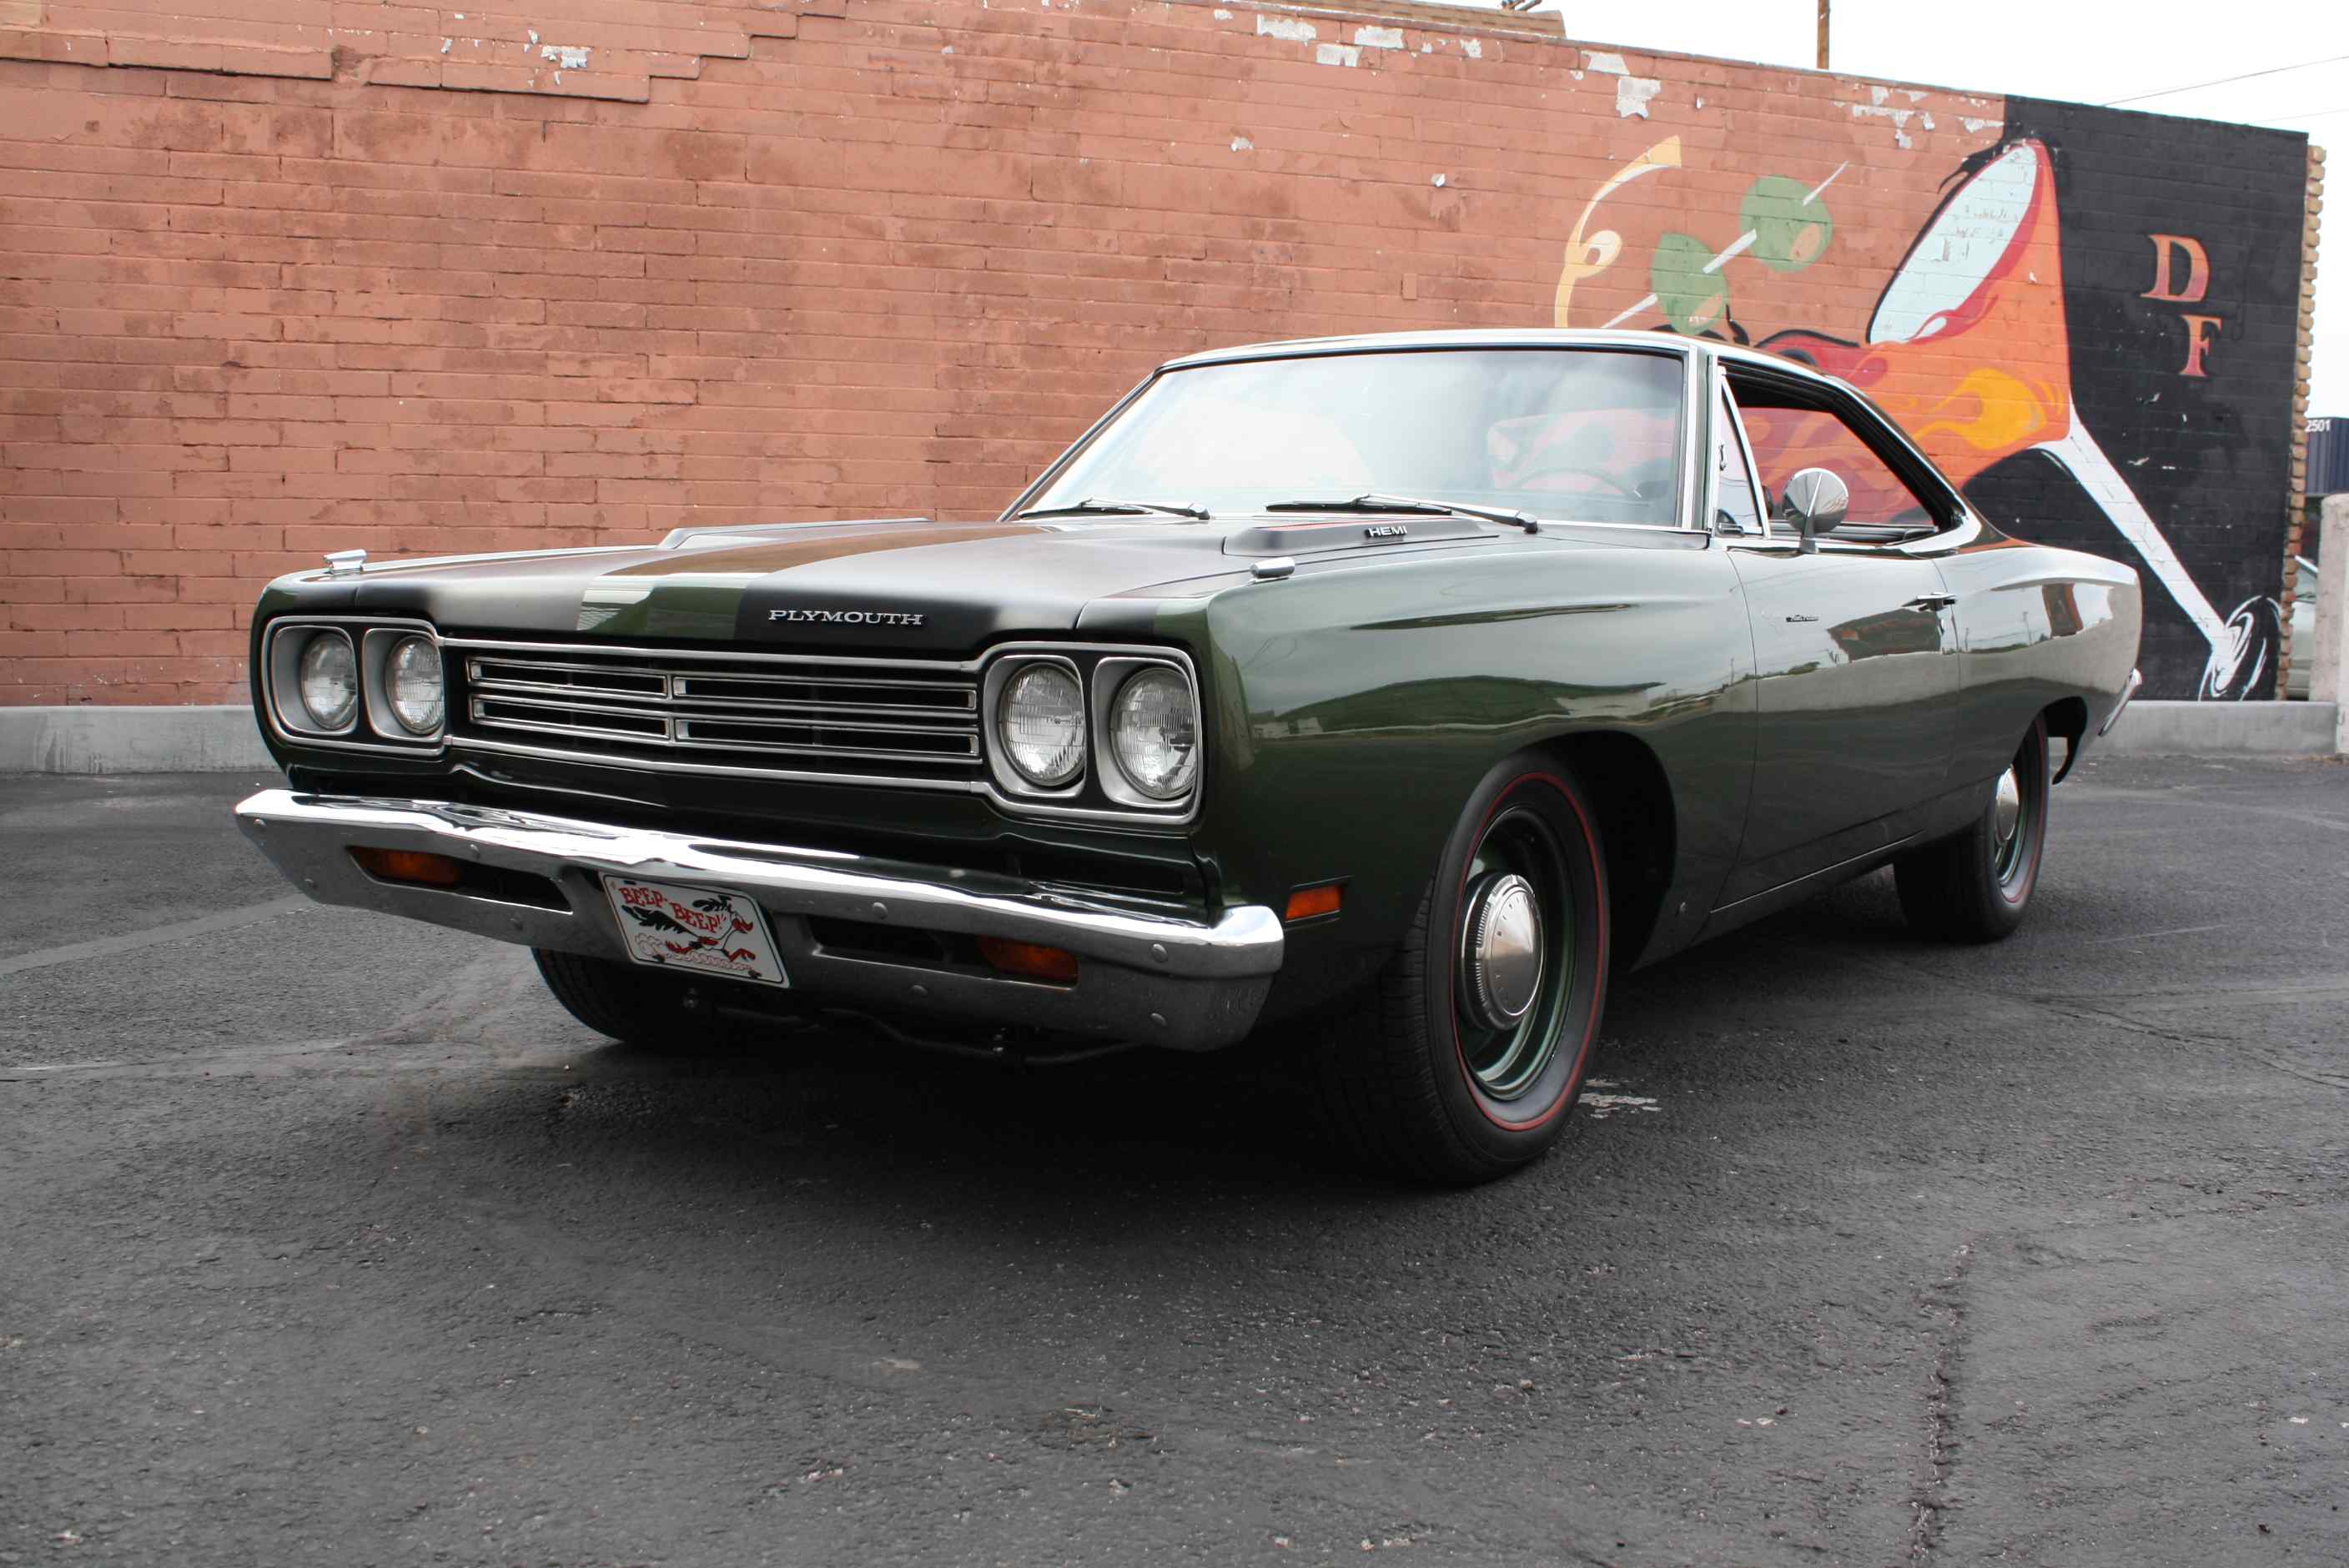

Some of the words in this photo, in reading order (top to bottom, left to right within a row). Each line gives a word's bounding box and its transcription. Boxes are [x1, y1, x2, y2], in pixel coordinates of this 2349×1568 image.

[2140, 234, 2211, 303] D
[2179, 314, 2222, 377] F
[1368, 525, 1408, 537] HEMI
[767, 610, 923, 626] PLYMOUTH
